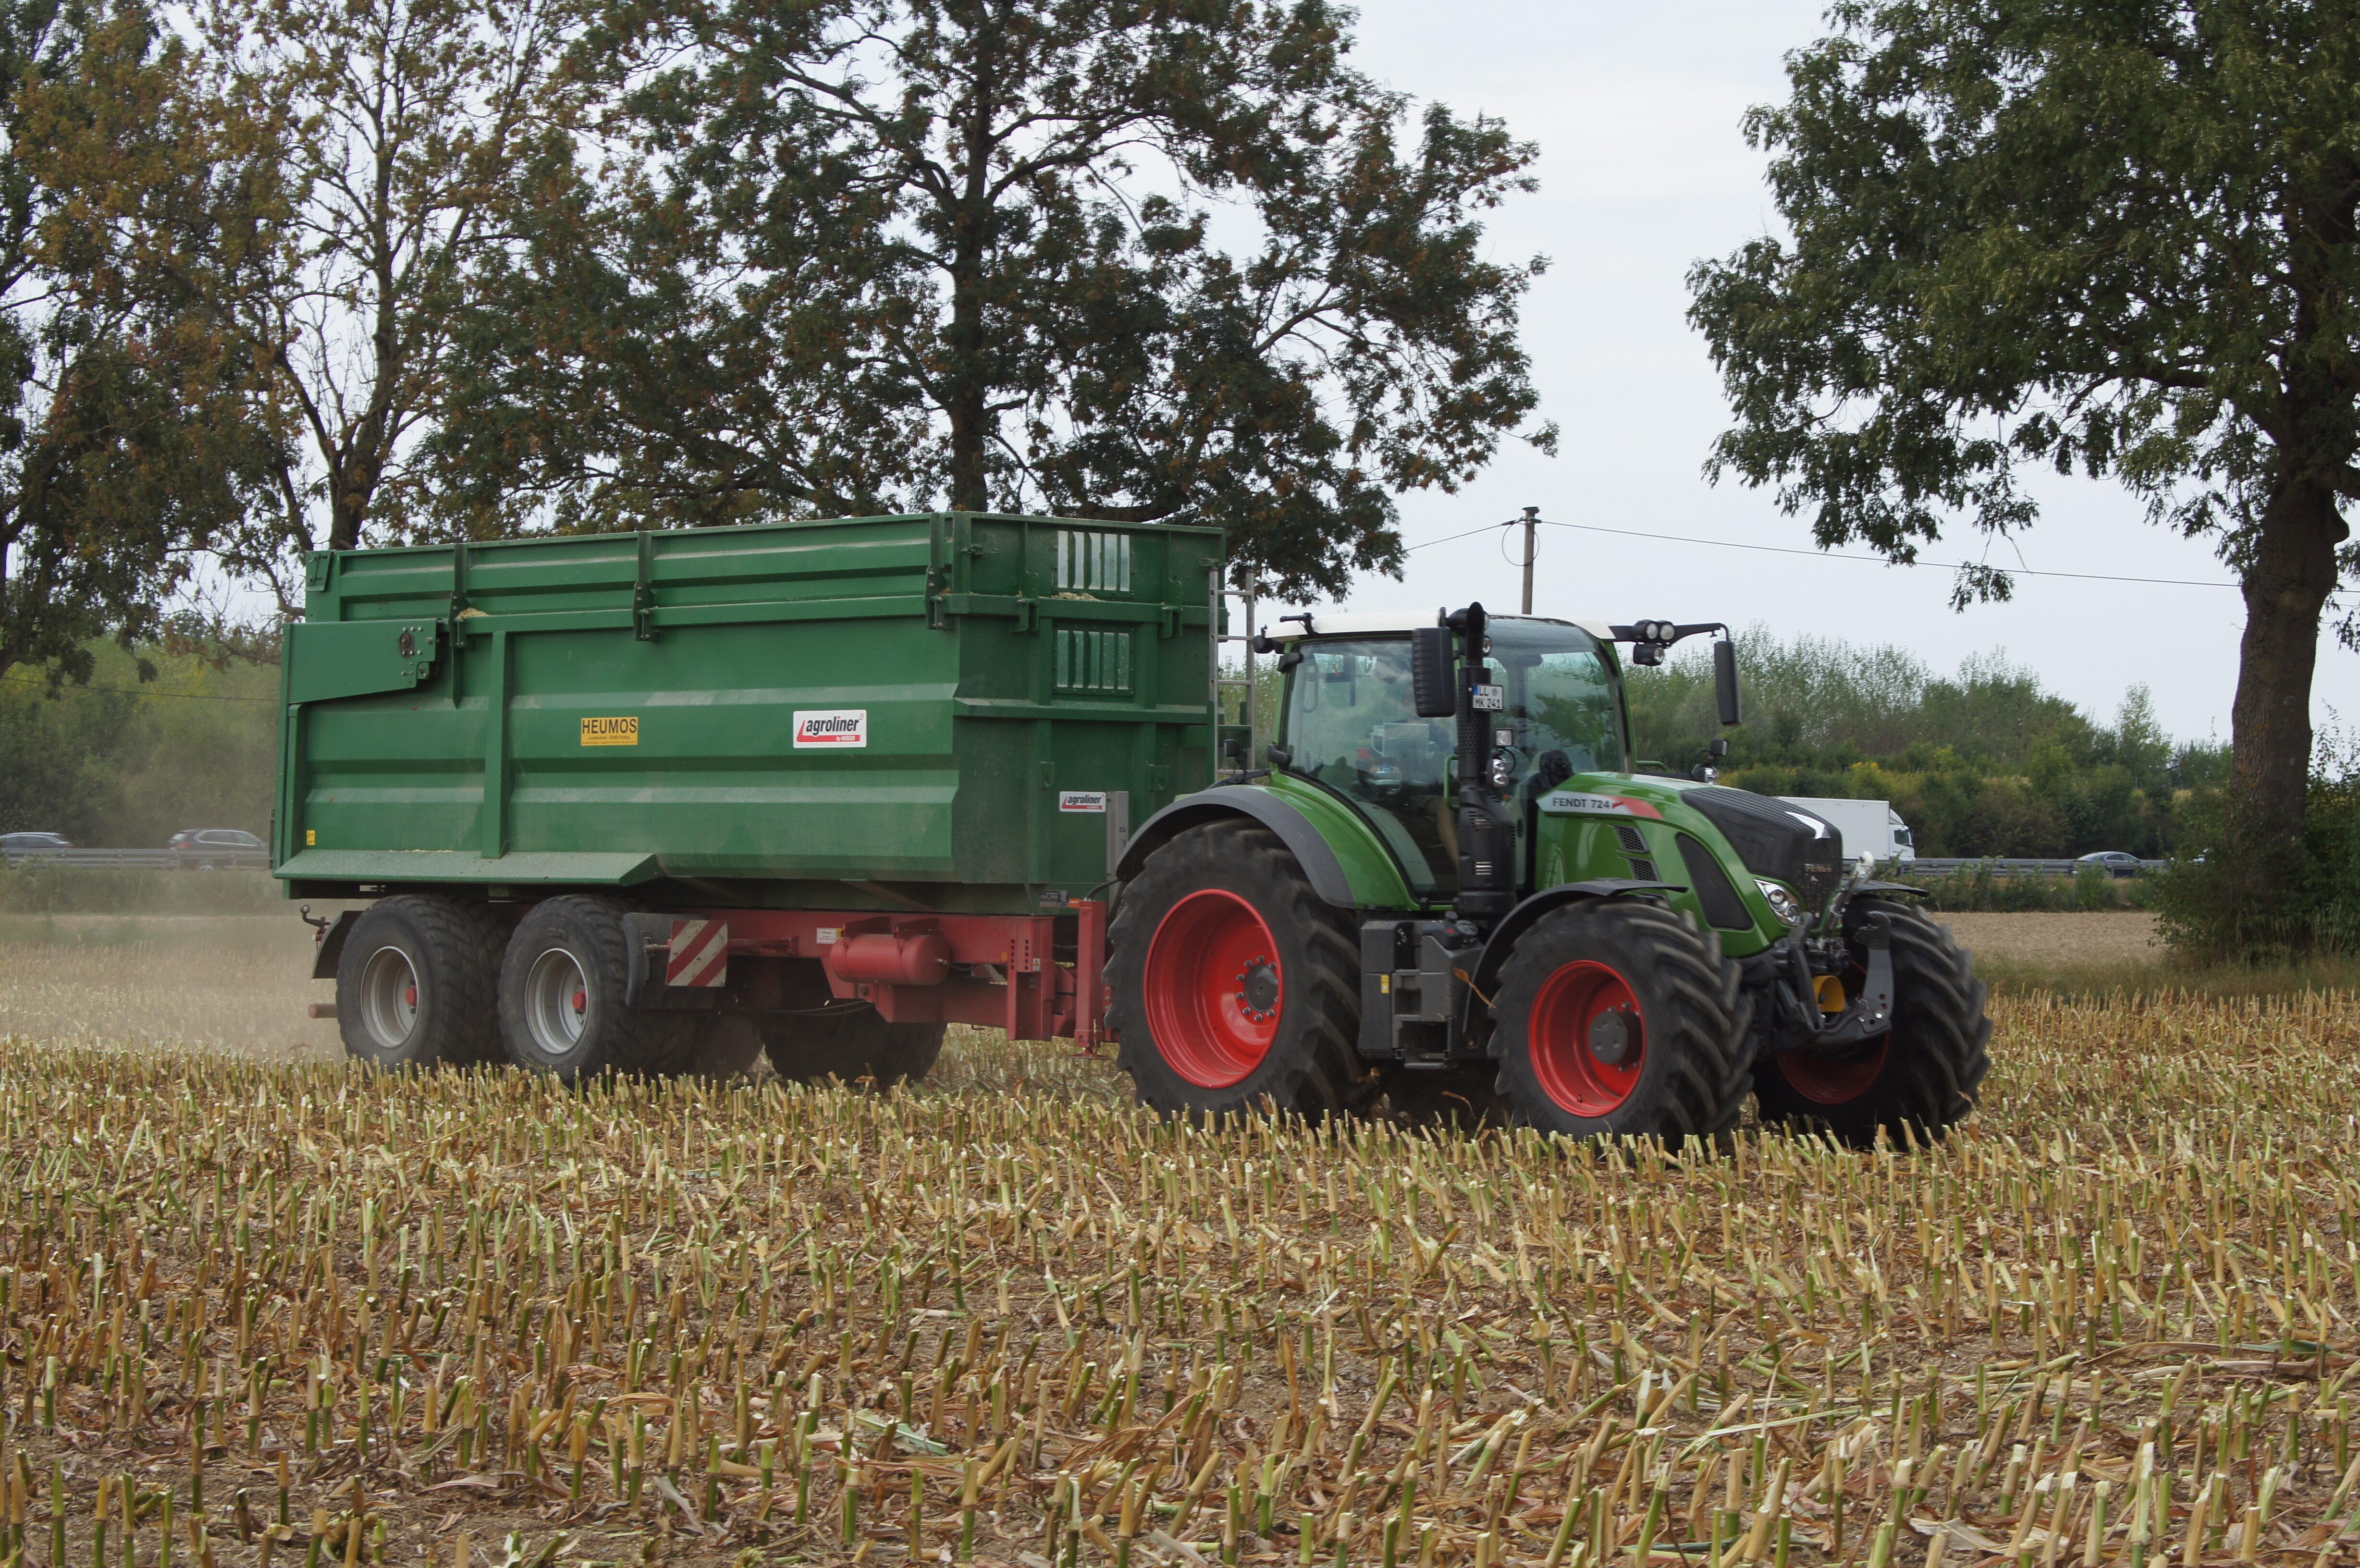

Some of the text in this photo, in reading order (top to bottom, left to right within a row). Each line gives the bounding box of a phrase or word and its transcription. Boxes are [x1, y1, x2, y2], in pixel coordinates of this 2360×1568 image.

[1479, 686, 1489, 696] LL
[1475, 698, 1500, 709] MK 241
[582, 718, 637, 734] HEUMOS
[806, 715, 860, 735] agroliner
[1068, 794, 1102, 806] agroliner
[1552, 797, 1587, 808] FENDT
[1591, 799, 1610, 809] 724
